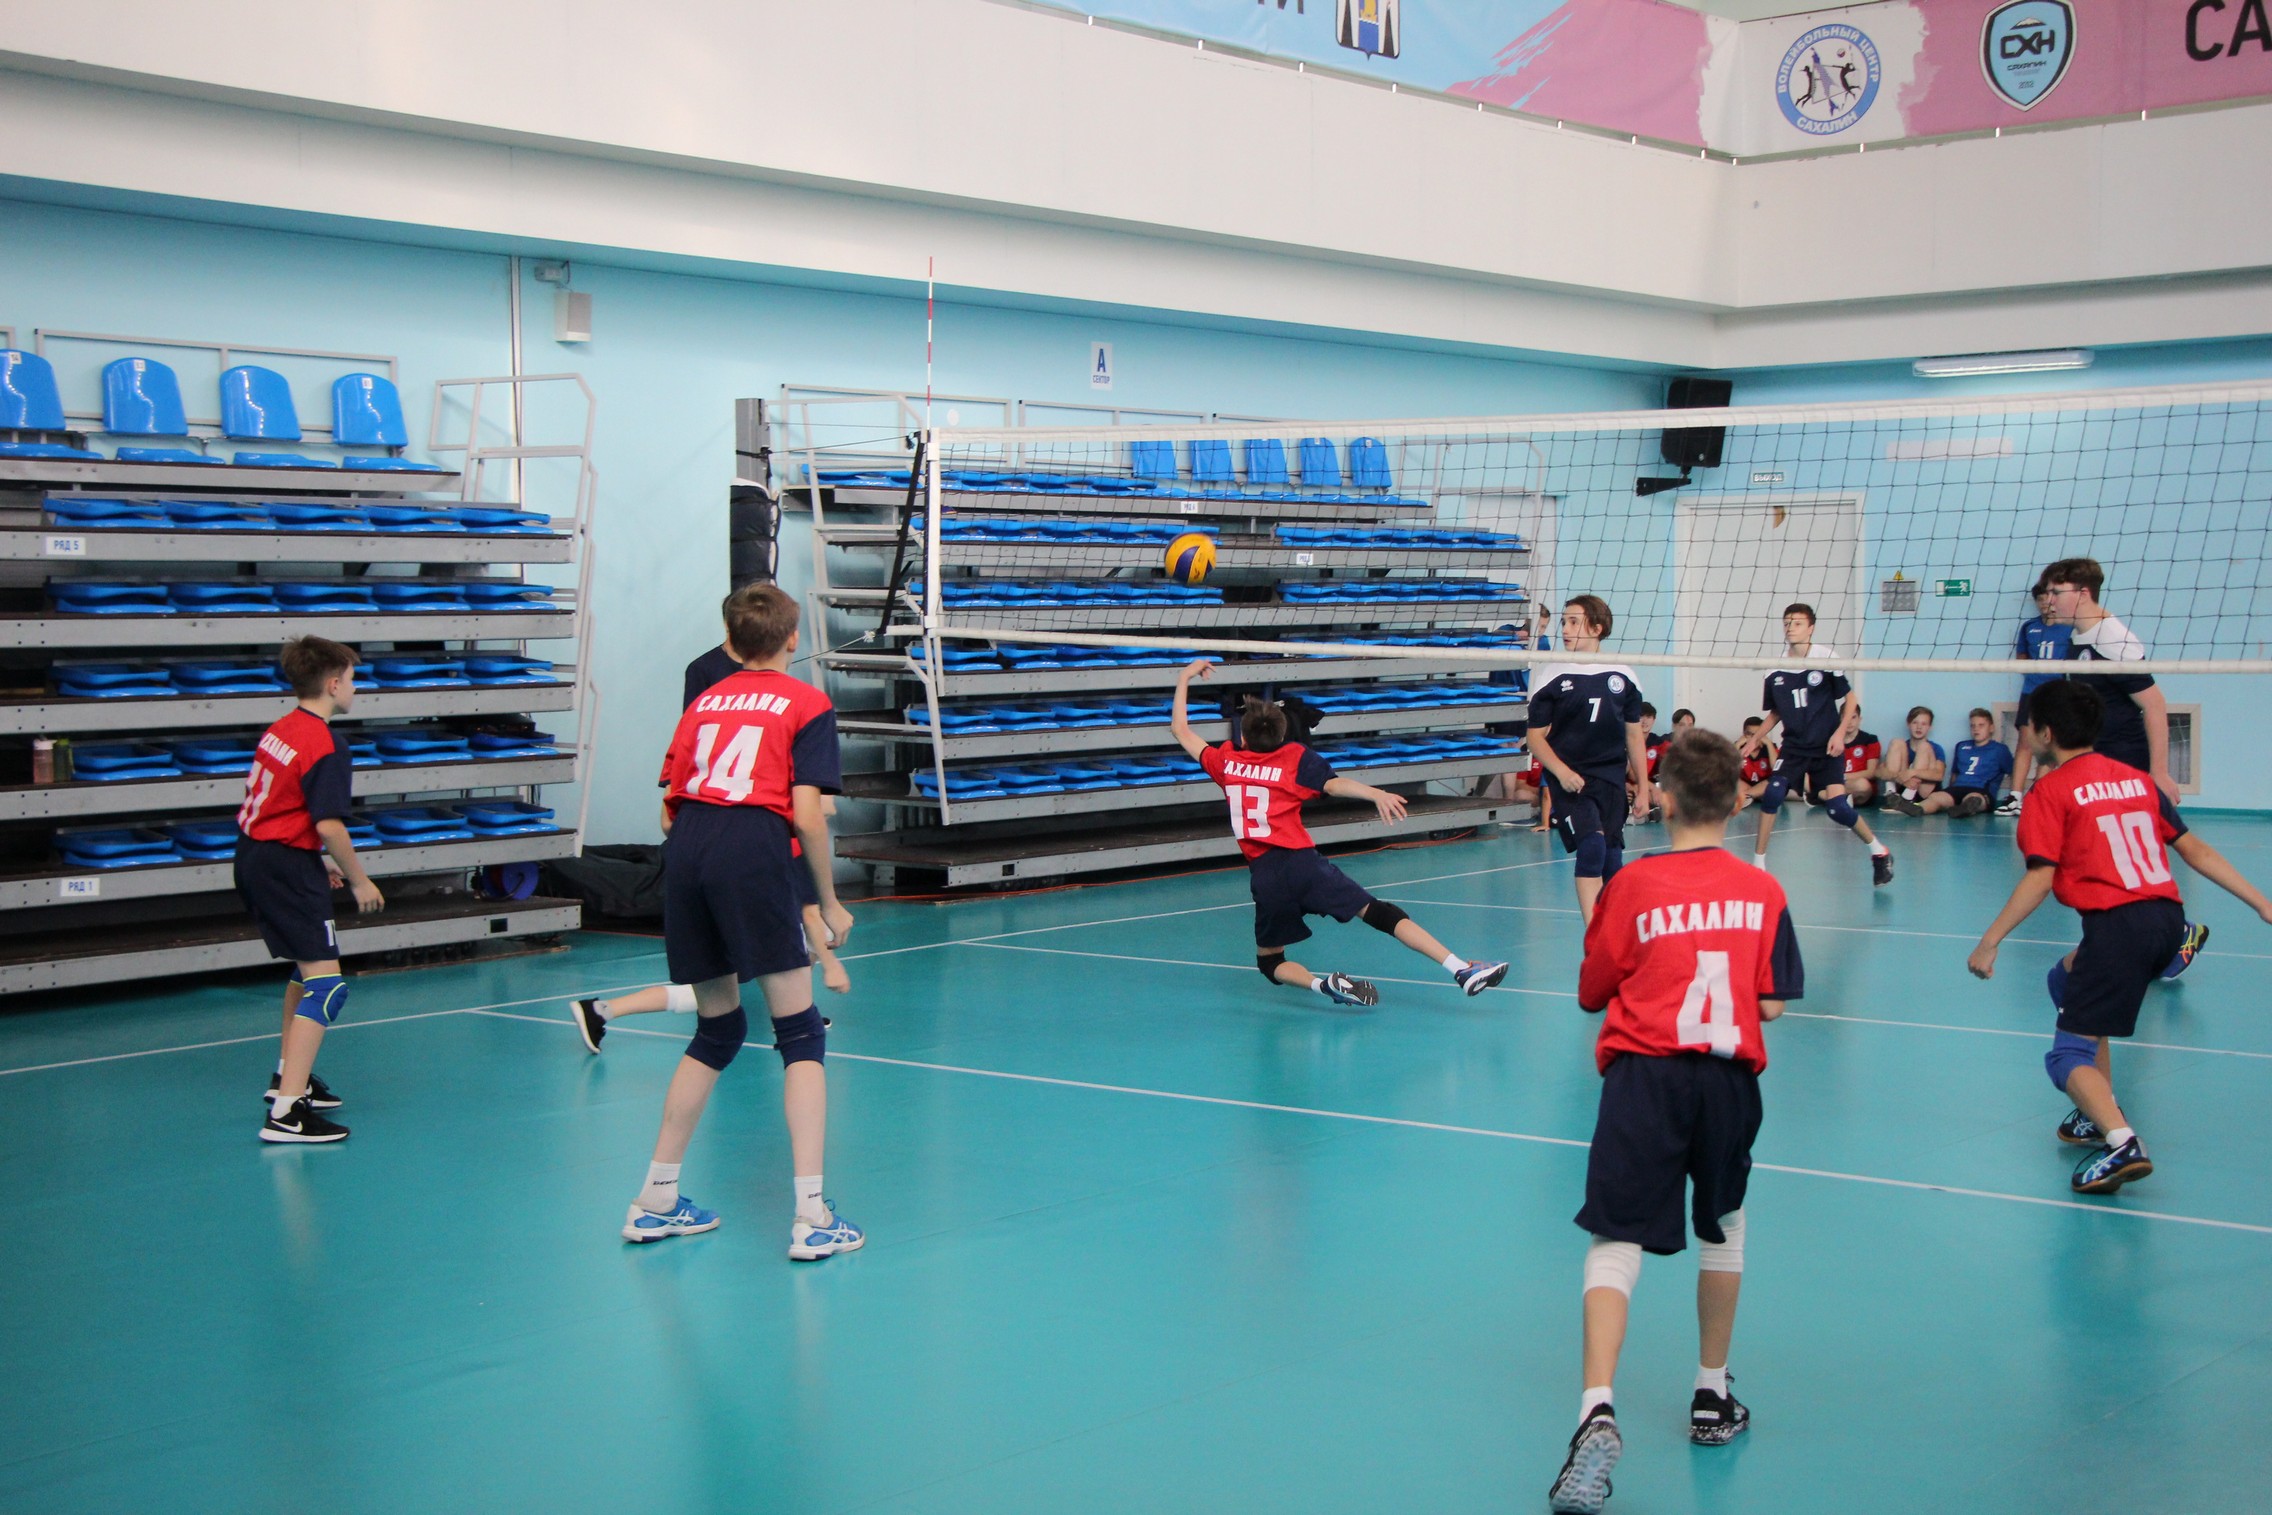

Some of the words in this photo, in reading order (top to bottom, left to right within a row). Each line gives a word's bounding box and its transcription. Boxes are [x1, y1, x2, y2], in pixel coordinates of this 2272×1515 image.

[1859, 38, 1880, 83] ЦЕНТР
[1796, 111, 1858, 133] САХАЛИН
[54, 539, 71, 551] РЯД
[74, 540, 79, 550] 5
[696, 693, 791, 716] САХАЛИН
[1588, 697, 1602, 723] 7
[686, 723, 764, 802] 14
[1223, 759, 1282, 782] АХАЛИН
[1968, 756, 1980, 772] 7
[1225, 784, 1272, 840] 13
[2095, 810, 2172, 890] 10
[69, 881, 85, 892] РЯД
[1636, 900, 1764, 944] САХАЛИН
[1676, 950, 1742, 1060] 4
